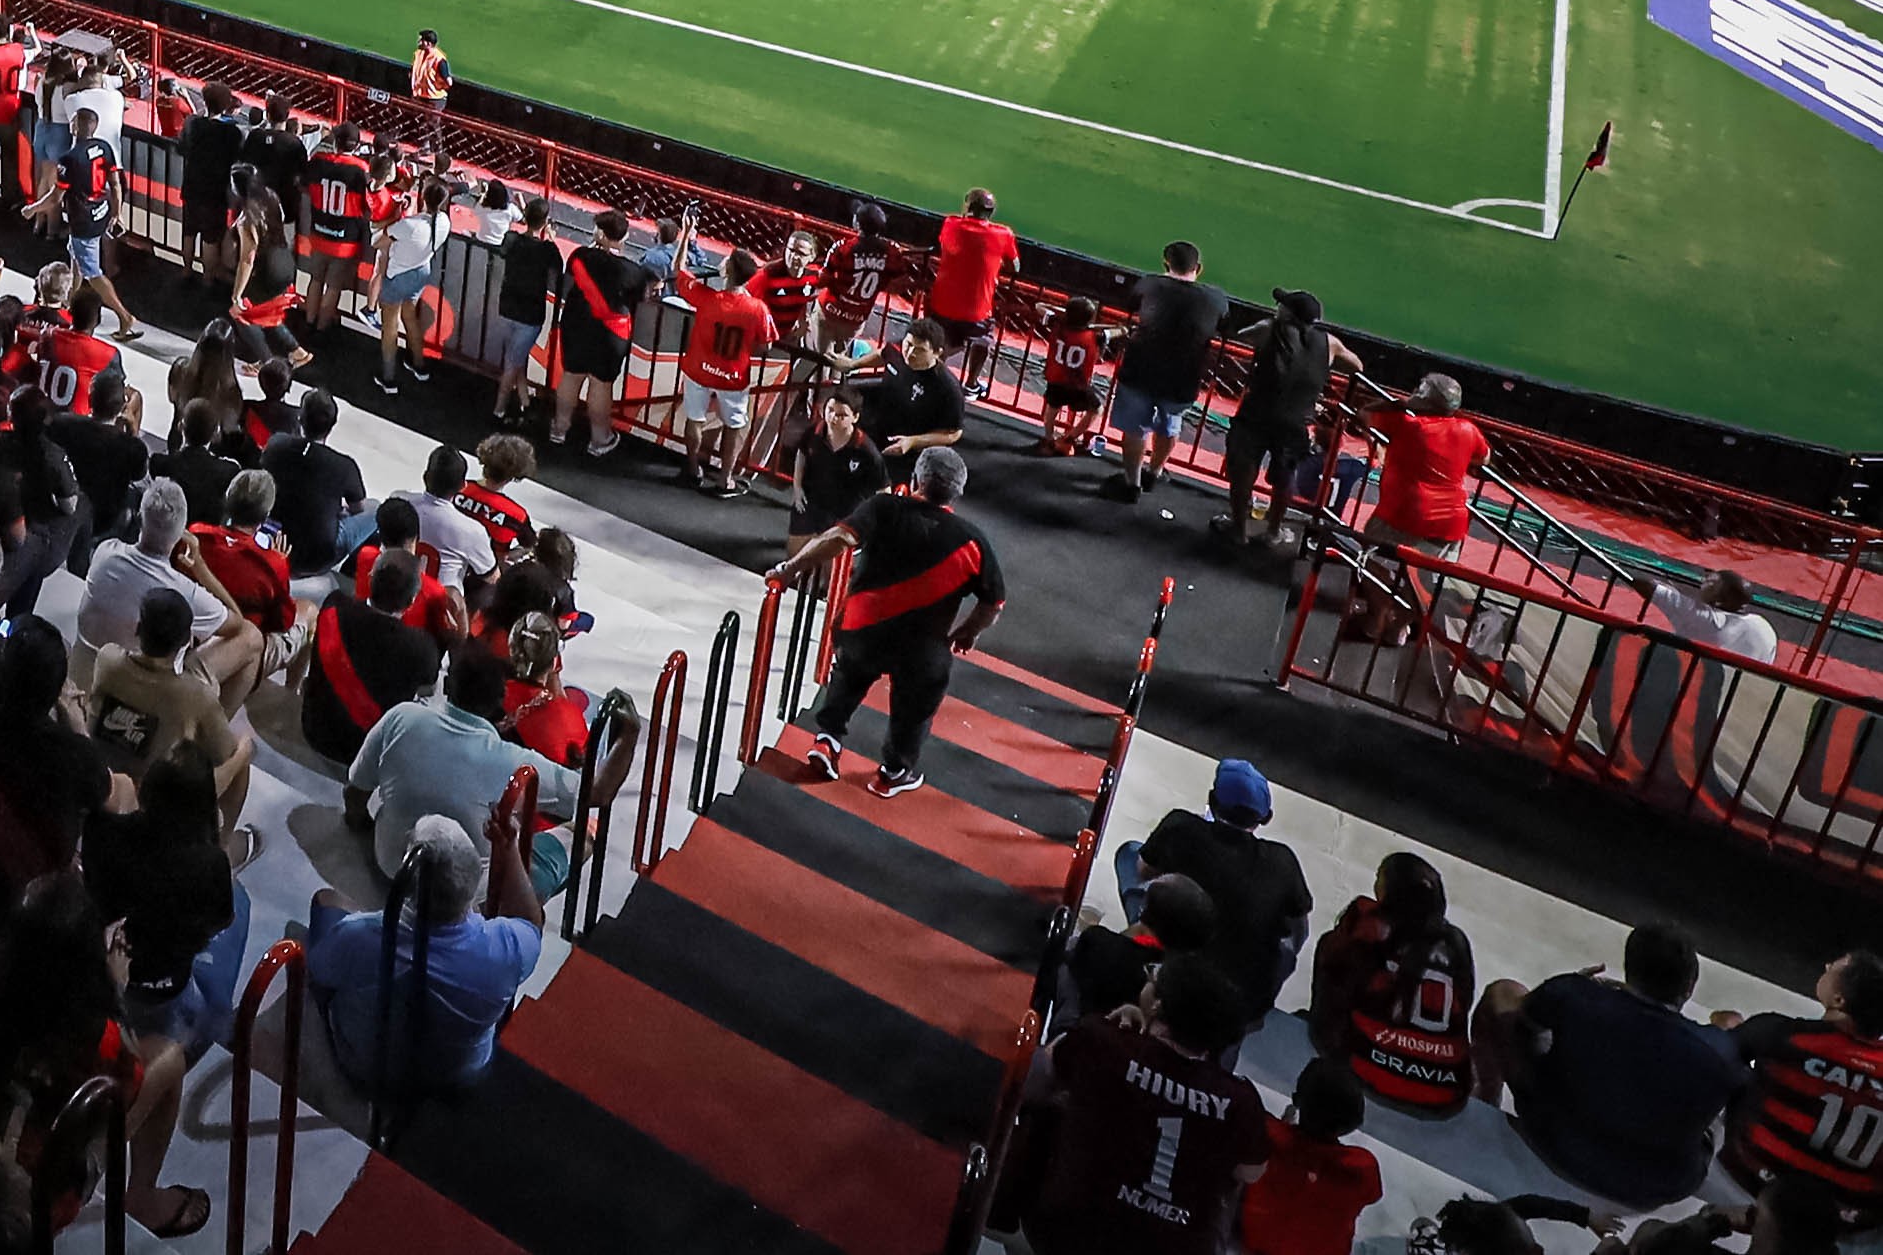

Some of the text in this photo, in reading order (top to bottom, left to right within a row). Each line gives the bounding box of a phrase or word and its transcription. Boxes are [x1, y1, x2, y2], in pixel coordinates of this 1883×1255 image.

[320, 178, 346, 217] 10
[847, 270, 879, 300] 10
[714, 321, 745, 361] 10
[1054, 339, 1086, 369] 10
[39, 359, 77, 406] 10
[454, 494, 506, 526] CAIXA
[1371, 1047, 1458, 1083] GRAVIA
[1124, 1060, 1231, 1121] HIURY
[1809, 1093, 1883, 1169] 10
[1142, 1116, 1183, 1202] 1
